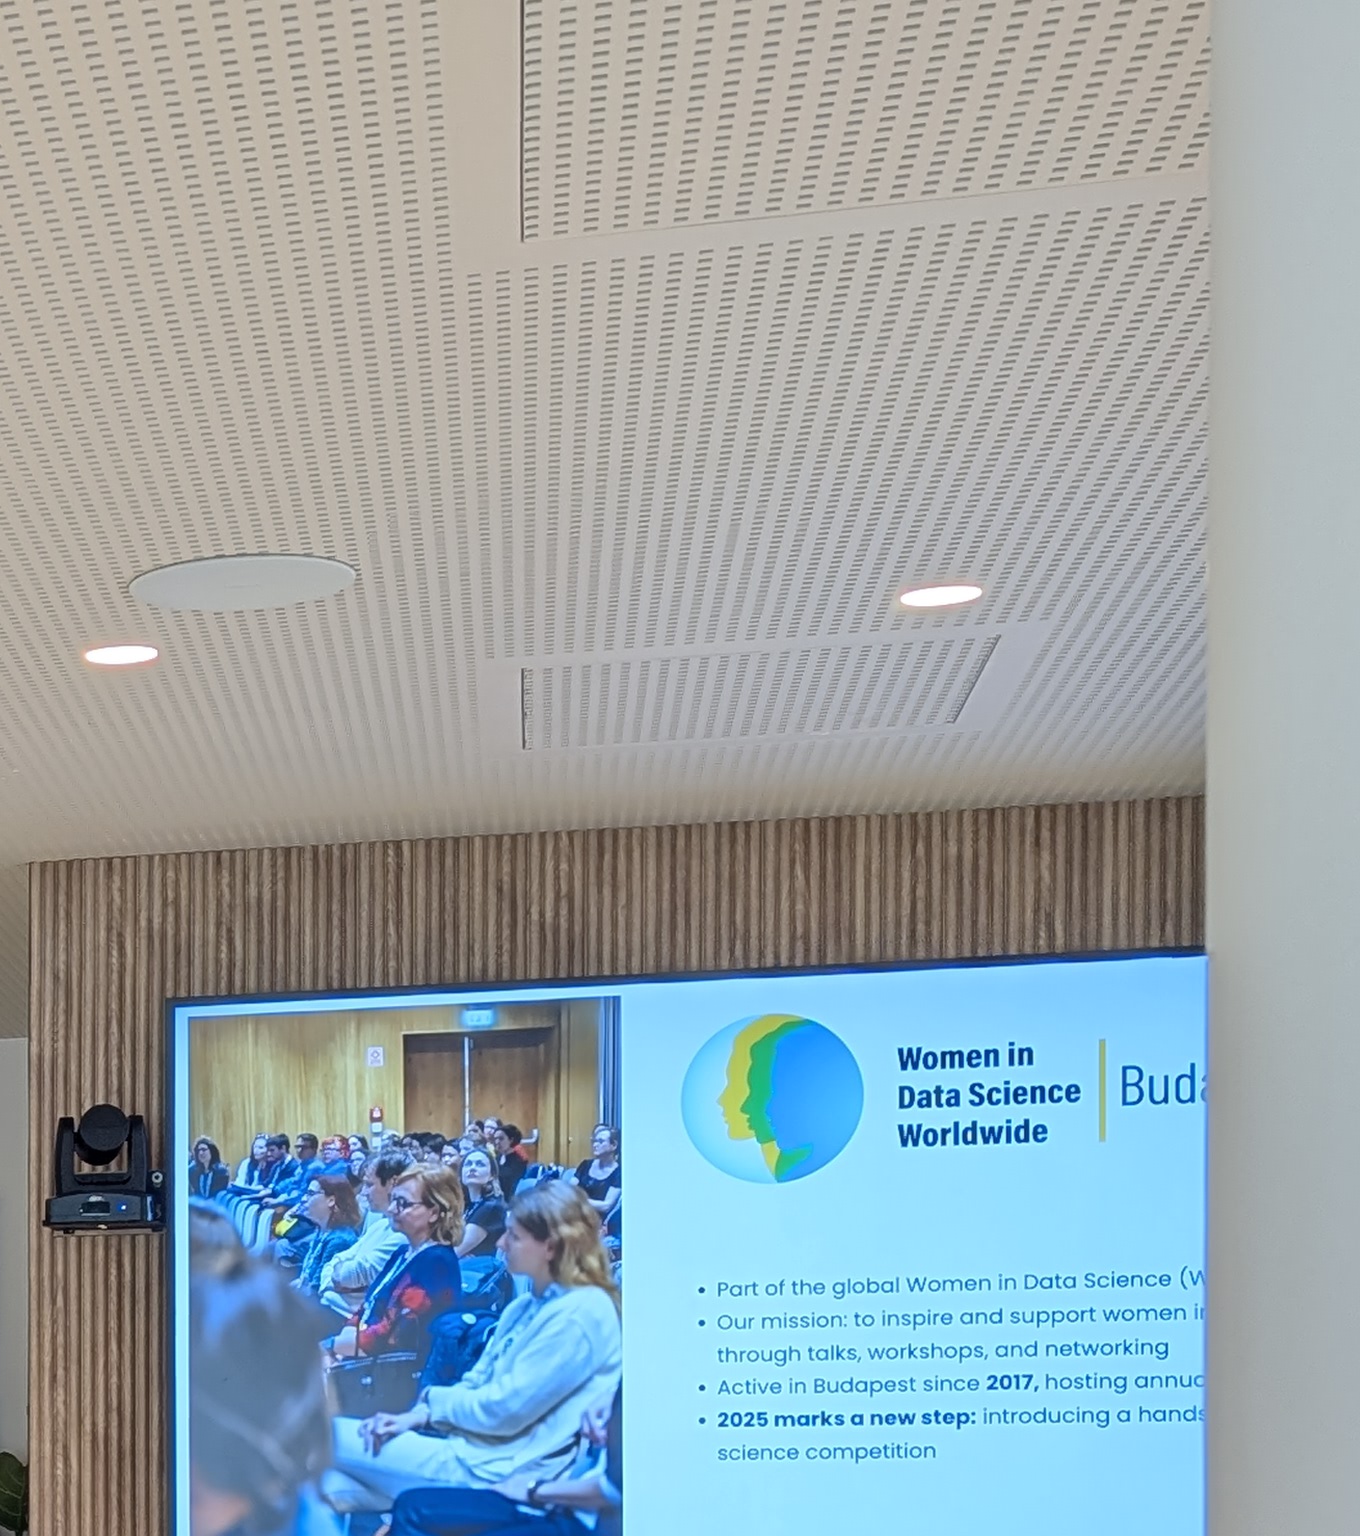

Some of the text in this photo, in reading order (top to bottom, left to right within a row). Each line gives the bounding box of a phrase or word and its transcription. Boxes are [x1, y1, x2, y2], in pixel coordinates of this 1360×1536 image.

[897, 1041, 1034, 1071] Women in
[898, 1080, 1081, 1109] Data Science
[1121, 1062, 1206, 1106] Bud
[897, 1118, 1048, 1148] Worldwide
[717, 1281, 759, 1297] Part
[765, 1278, 786, 1296] of
[791, 1279, 826, 1296] the
[832, 1276, 900, 1300] global
[906, 1276, 992, 1293] Women
[998, 1273, 1017, 1291] in
[1024, 1273, 1077, 1290] Data
[1084, 1270, 1172, 1289] Science
[717, 1314, 755, 1330] Our
[761, 1311, 848, 1330] mission:
[854, 1311, 876, 1327] to
[882, 1309, 954, 1331] inspire
[960, 1308, 1004, 1326] and
[1010, 1306, 1097, 1329] support
[1103, 1306, 1187, 1322] women
[717, 1338, 1169, 1367] through talks, workshops, and networking
[717, 1378, 783, 1395] Active
[788, 1377, 807, 1394] in
[813, 1376, 917, 1398] Budapest
[923, 1375, 981, 1392] since
[986, 1373, 1040, 1392] 2017,
[1045, 1372, 1128, 1394] hosting
[717, 1411, 769, 1428] 2025
[774, 1411, 845, 1427] marks
[850, 1413, 864, 1426] a
[870, 1412, 916, 1426] new
[921, 1409, 977, 1430] step:
[983, 1406, 1110, 1428] introducing
[1116, 1409, 1131, 1422] a
[717, 1442, 937, 1464] science competition
